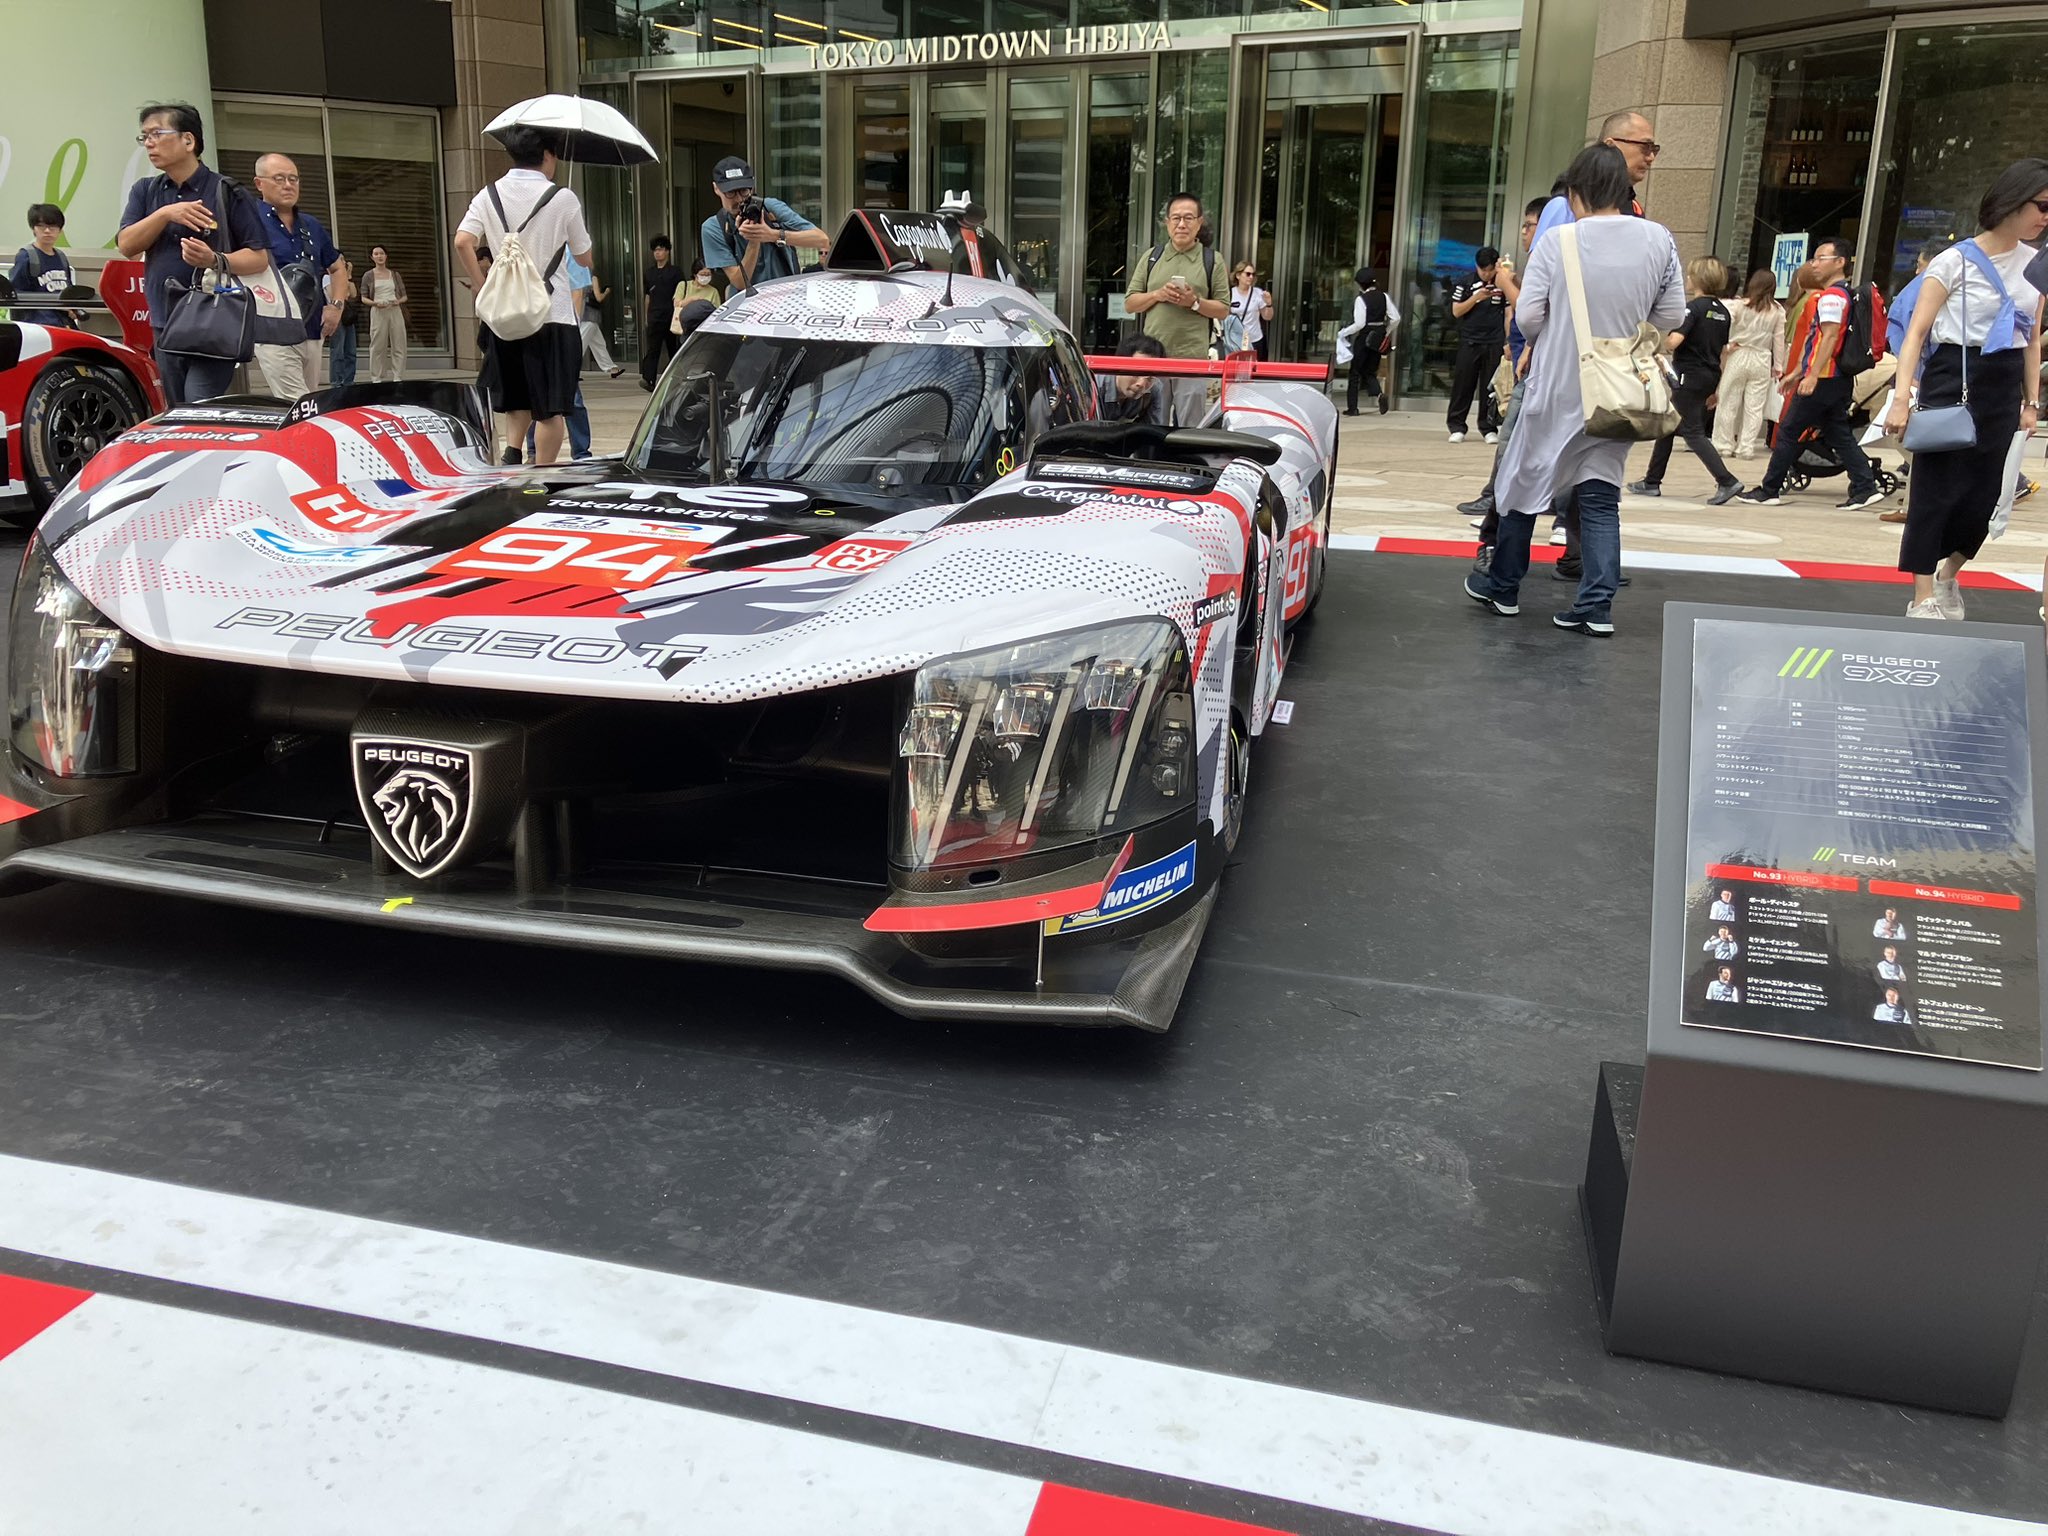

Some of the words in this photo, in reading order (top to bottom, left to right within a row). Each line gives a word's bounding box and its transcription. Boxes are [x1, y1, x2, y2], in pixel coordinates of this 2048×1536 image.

[806, 40, 895, 69] TOKYO
[905, 29, 1050, 64] MIDTOWN
[1065, 20, 1172, 54] HIBIYA
[880, 213, 948, 263] Capgemini
[291, 400, 318, 421] #94
[115, 430, 231, 444] Capgemini
[363, 415, 454, 440] PEUGEOT
[1023, 485, 1165, 509] Capgemini
[549, 499, 769, 522] TotalEnergies
[451, 533, 670, 583] 94
[214, 606, 708, 669] PEUGEOT
[1842, 654, 1941, 669] PEUGEOT
[1843, 665, 1941, 687] 9X8
[364, 749, 464, 770] PEUGEOT
[1838, 853, 1896, 868] TEAM
[1102, 860, 1188, 910] MICHELIN
[1753, 871, 1782, 880] No.93
[1783, 874, 1820, 885] HYBRID
[1915, 888, 1946, 898] No.94
[1947, 891, 1985, 902] HYBRID
